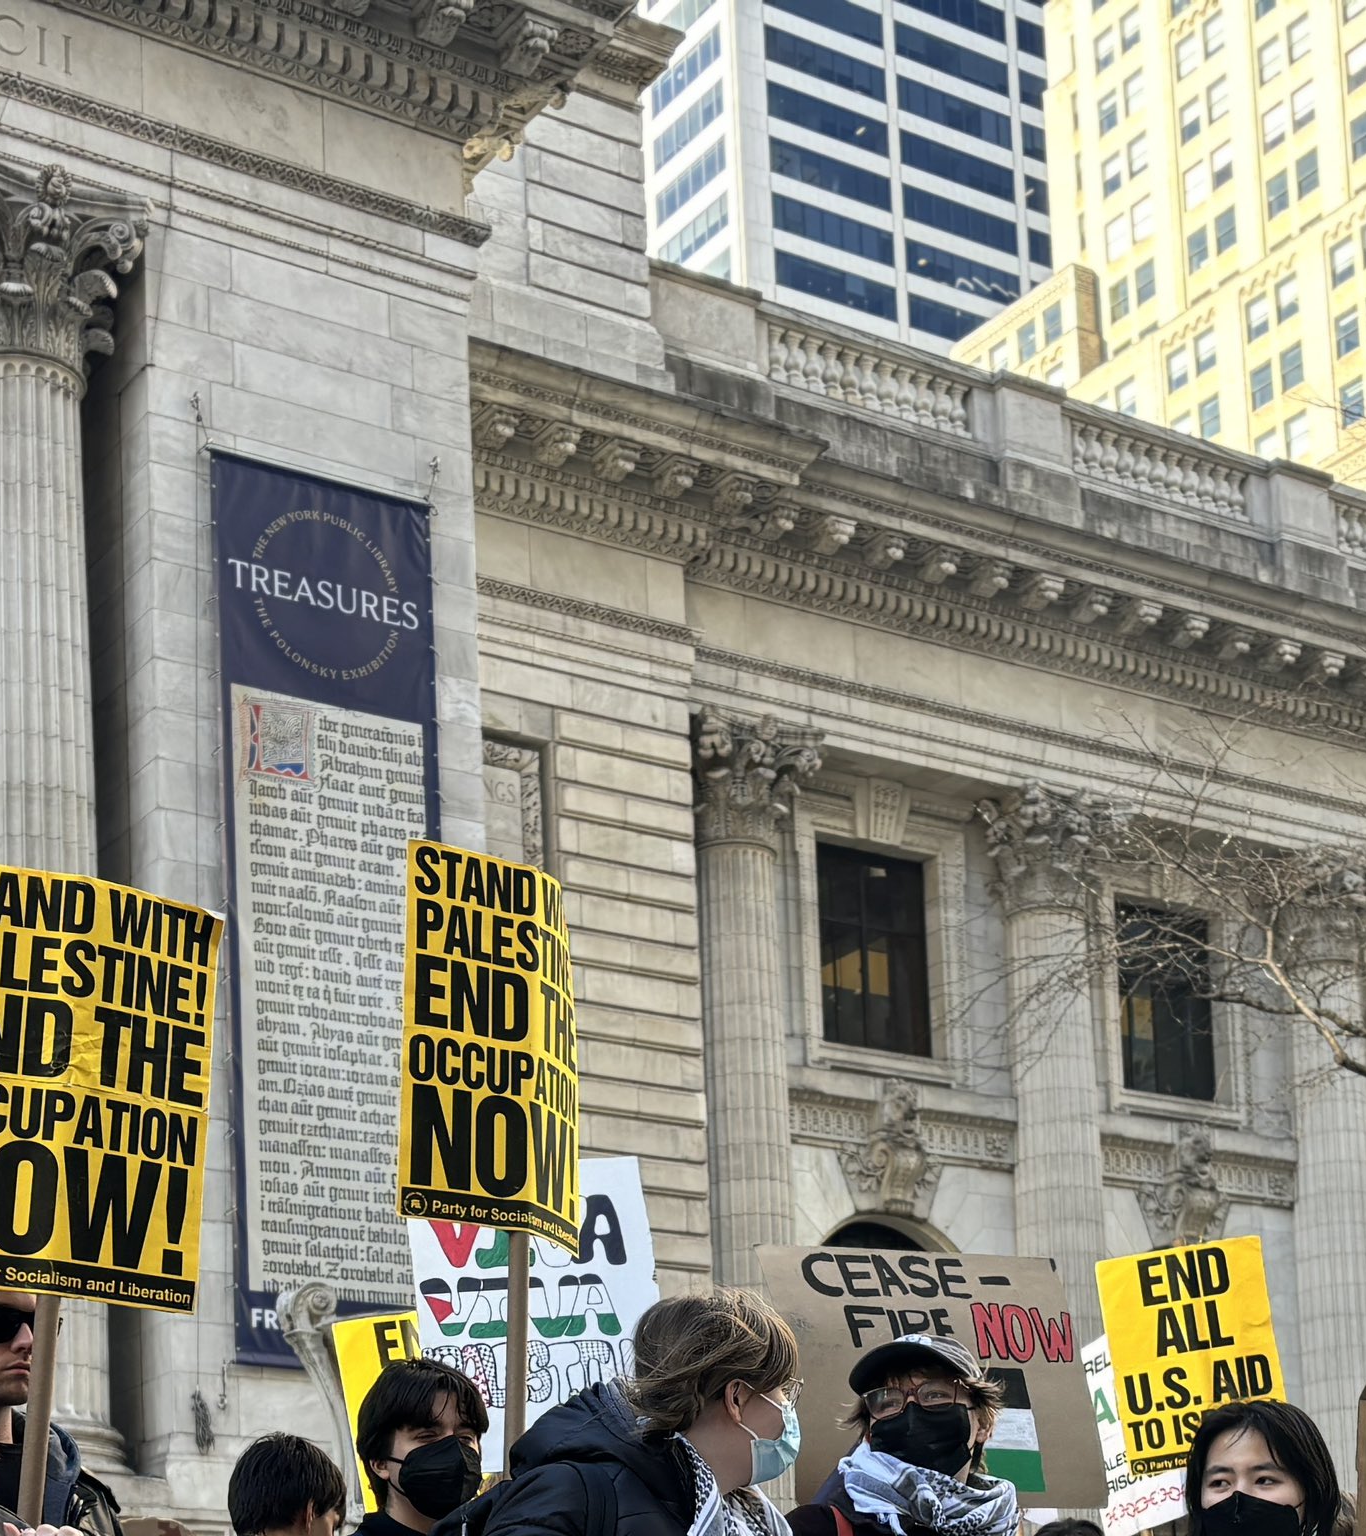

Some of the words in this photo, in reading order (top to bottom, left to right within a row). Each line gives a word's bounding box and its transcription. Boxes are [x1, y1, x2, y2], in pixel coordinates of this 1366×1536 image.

[252, 532, 269, 560] THE
[265, 514, 289, 538] NEW
[287, 509, 320, 523] YORK
[323, 513, 366, 542] PUBLIC
[366, 540, 399, 594] LIBRARY
[228, 559, 419, 630] TREASURES
[254, 597, 272, 627] THE
[270, 630, 336, 679] POLONSKY
[342, 629, 399, 680] EXHIBITION
[415, 846, 536, 916] STAND
[109, 888, 214, 967] WITH
[415, 953, 529, 1043] END
[540, 979, 576, 1072] THE
[94, 1005, 206, 1108] THE
[409, 1033, 576, 1128] OCCUPATION
[409, 1084, 576, 1223] NOW!
[432, 1200, 467, 1218] Party
[470, 1205, 488, 1218] for
[5, 1266, 82, 1289] Socialism
[86, 1277, 115, 1294] and
[119, 1281, 191, 1305] Liberation
[1137, 1247, 1229, 1307] END
[970, 1302, 1073, 1363] NOW
[1156, 1301, 1234, 1358] ALL
[1124, 1366, 1202, 1416] U.S.
[1212, 1354, 1273, 1401] AID
[1127, 1418, 1165, 1451] TO
